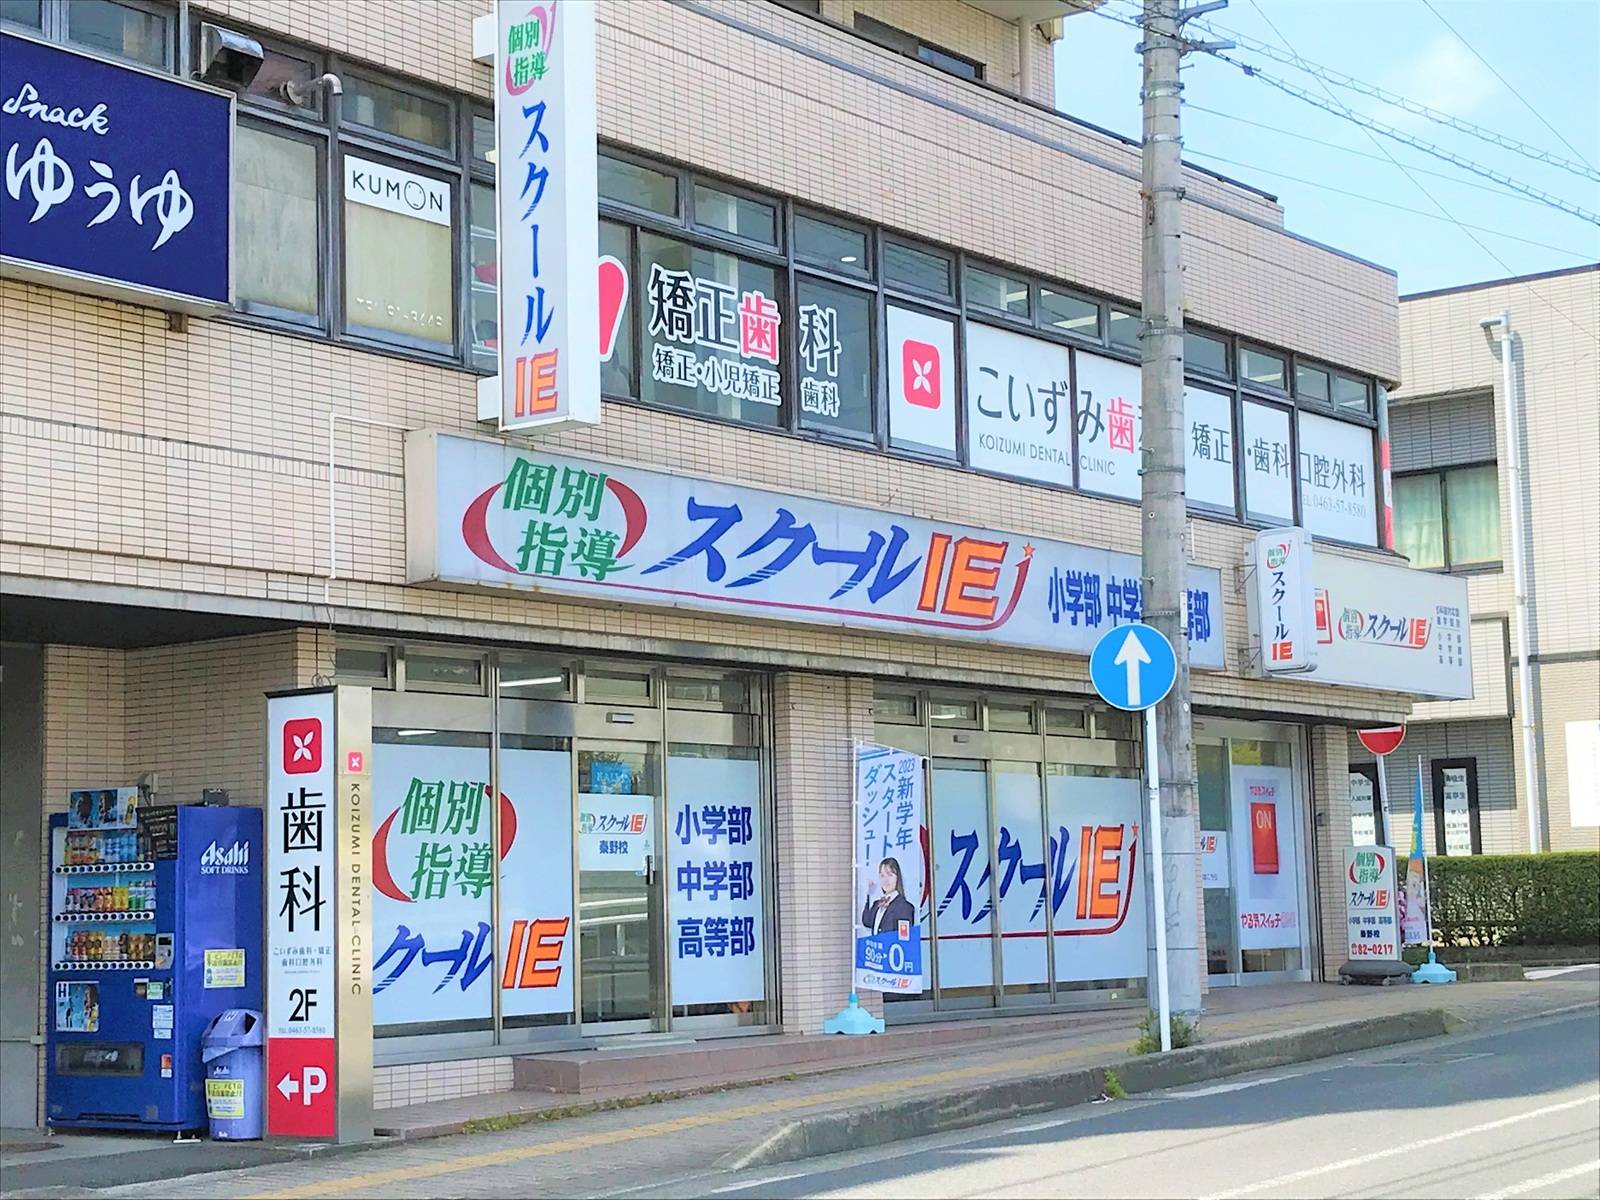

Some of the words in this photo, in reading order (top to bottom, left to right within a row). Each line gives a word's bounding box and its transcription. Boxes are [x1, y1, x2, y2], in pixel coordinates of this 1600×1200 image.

[508, 19, 541, 54] 個別
[514, 51, 550, 87] 指導
[2, 83, 110, 135] Snack
[5, 138, 195, 251] ゆうゆ
[351, 169, 444, 213] KUMON
[977, 366, 1144, 454] こいずみ歯
[978, 432, 1027, 457] KOIZUMI
[1029, 443, 1071, 466] DENTAL
[1079, 454, 1117, 476] CLINIC
[502, 456, 609, 522] 個別
[515, 519, 636, 582] 指導
[1047, 566, 1102, 629] 小学部
[350, 783, 361, 857] KOIZUMI
[400, 776, 485, 835] 個別
[674, 804, 753, 846] 小学部
[882, 762, 897, 858] スタート
[1256, 810, 1272, 830] ON
[200, 840, 249, 866] Asahi
[200, 865, 220, 874] SOFT
[221, 865, 249, 874] DRINKS
[279, 787, 327, 933] 歯科
[409, 842, 504, 900] 指導
[350, 863, 361, 928] DENTAL
[676, 860, 754, 901] 中学部
[677, 915, 755, 960] 高等部
[350, 934, 362, 996] CLINIC
[288, 988, 318, 1022] 2F
[303, 1067, 328, 1106] P
